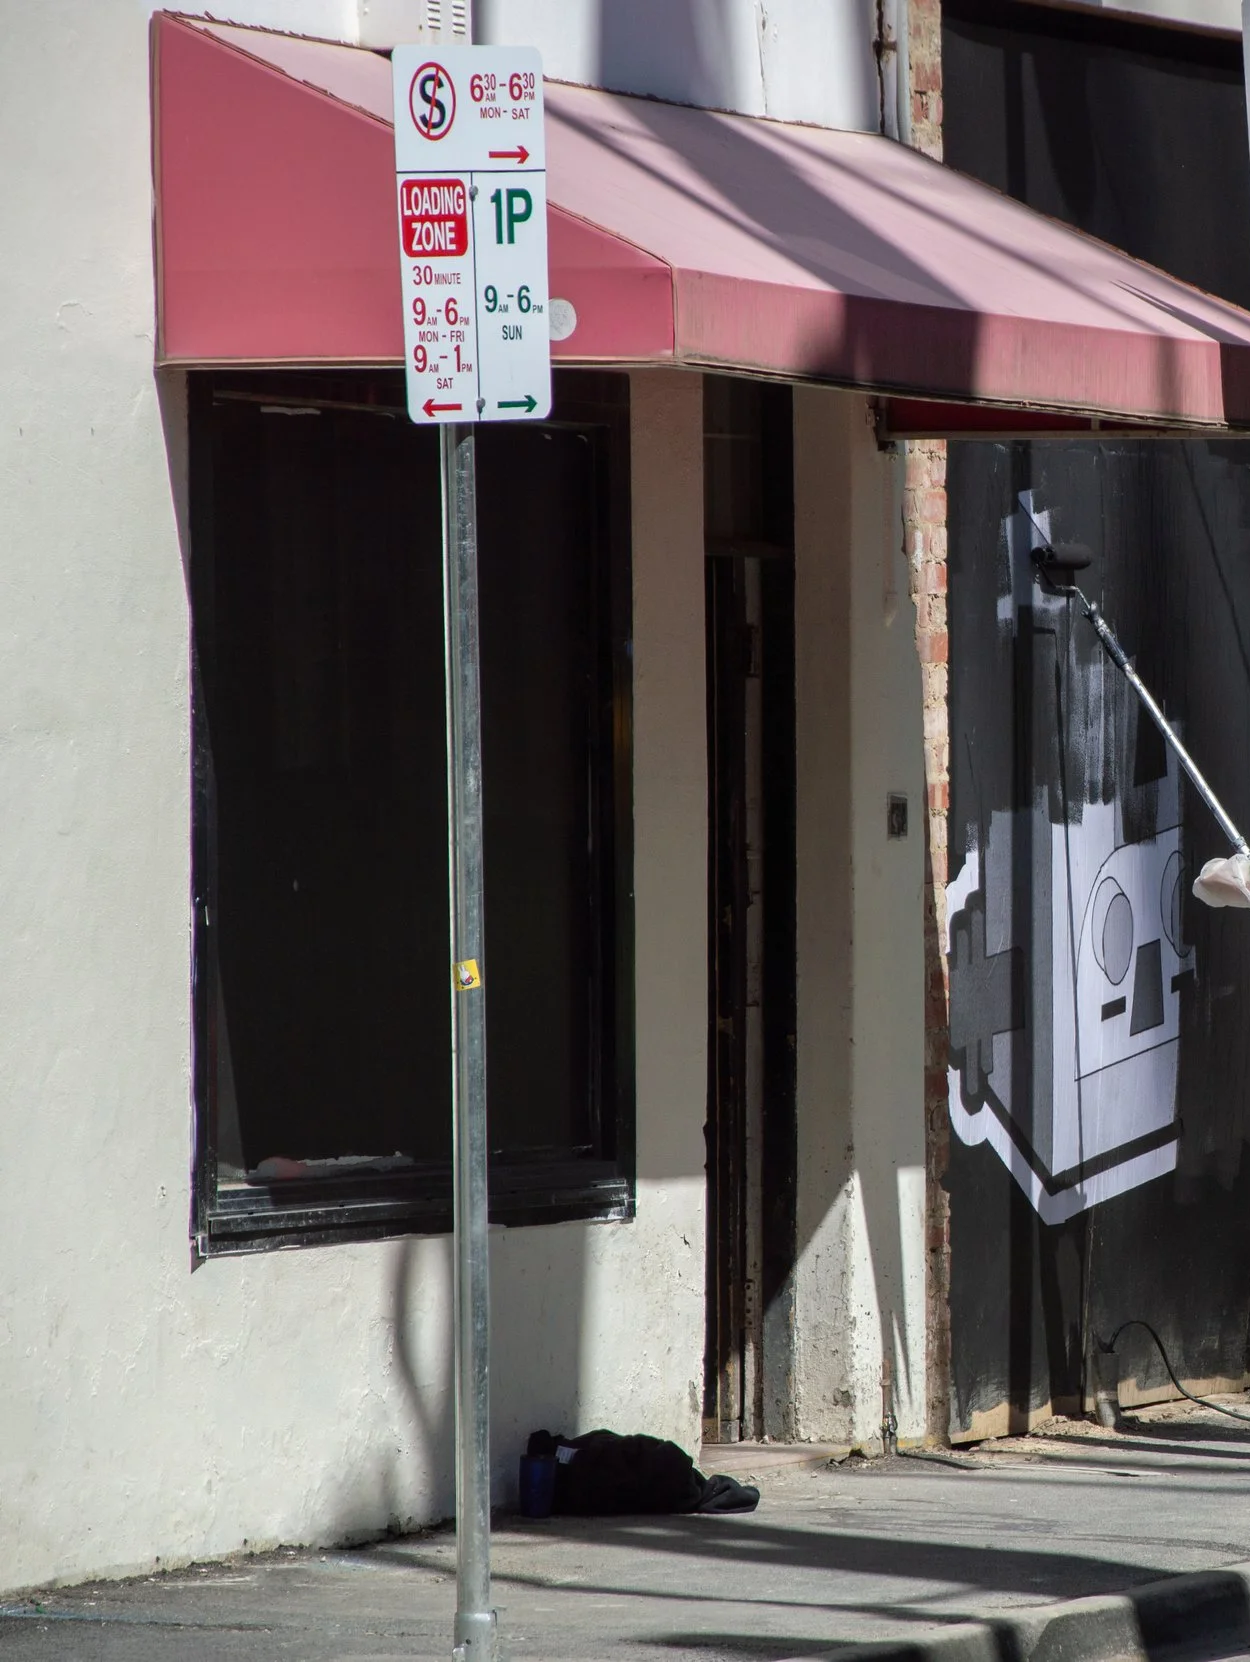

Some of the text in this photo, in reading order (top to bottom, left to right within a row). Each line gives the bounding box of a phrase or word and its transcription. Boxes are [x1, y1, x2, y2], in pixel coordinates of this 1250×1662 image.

[480, 107, 501, 119] MON
[511, 108, 530, 120] SAT
[402, 186, 465, 217] LOADING
[490, 188, 533, 245] 1P
[411, 221, 457, 251] ZONE
[412, 265, 461, 286] 30 MINUTE
[419, 330, 439, 343] MON
[450, 330, 465, 342] FRI
[502, 325, 523, 341] SUN
[436, 377, 454, 390] SAT
